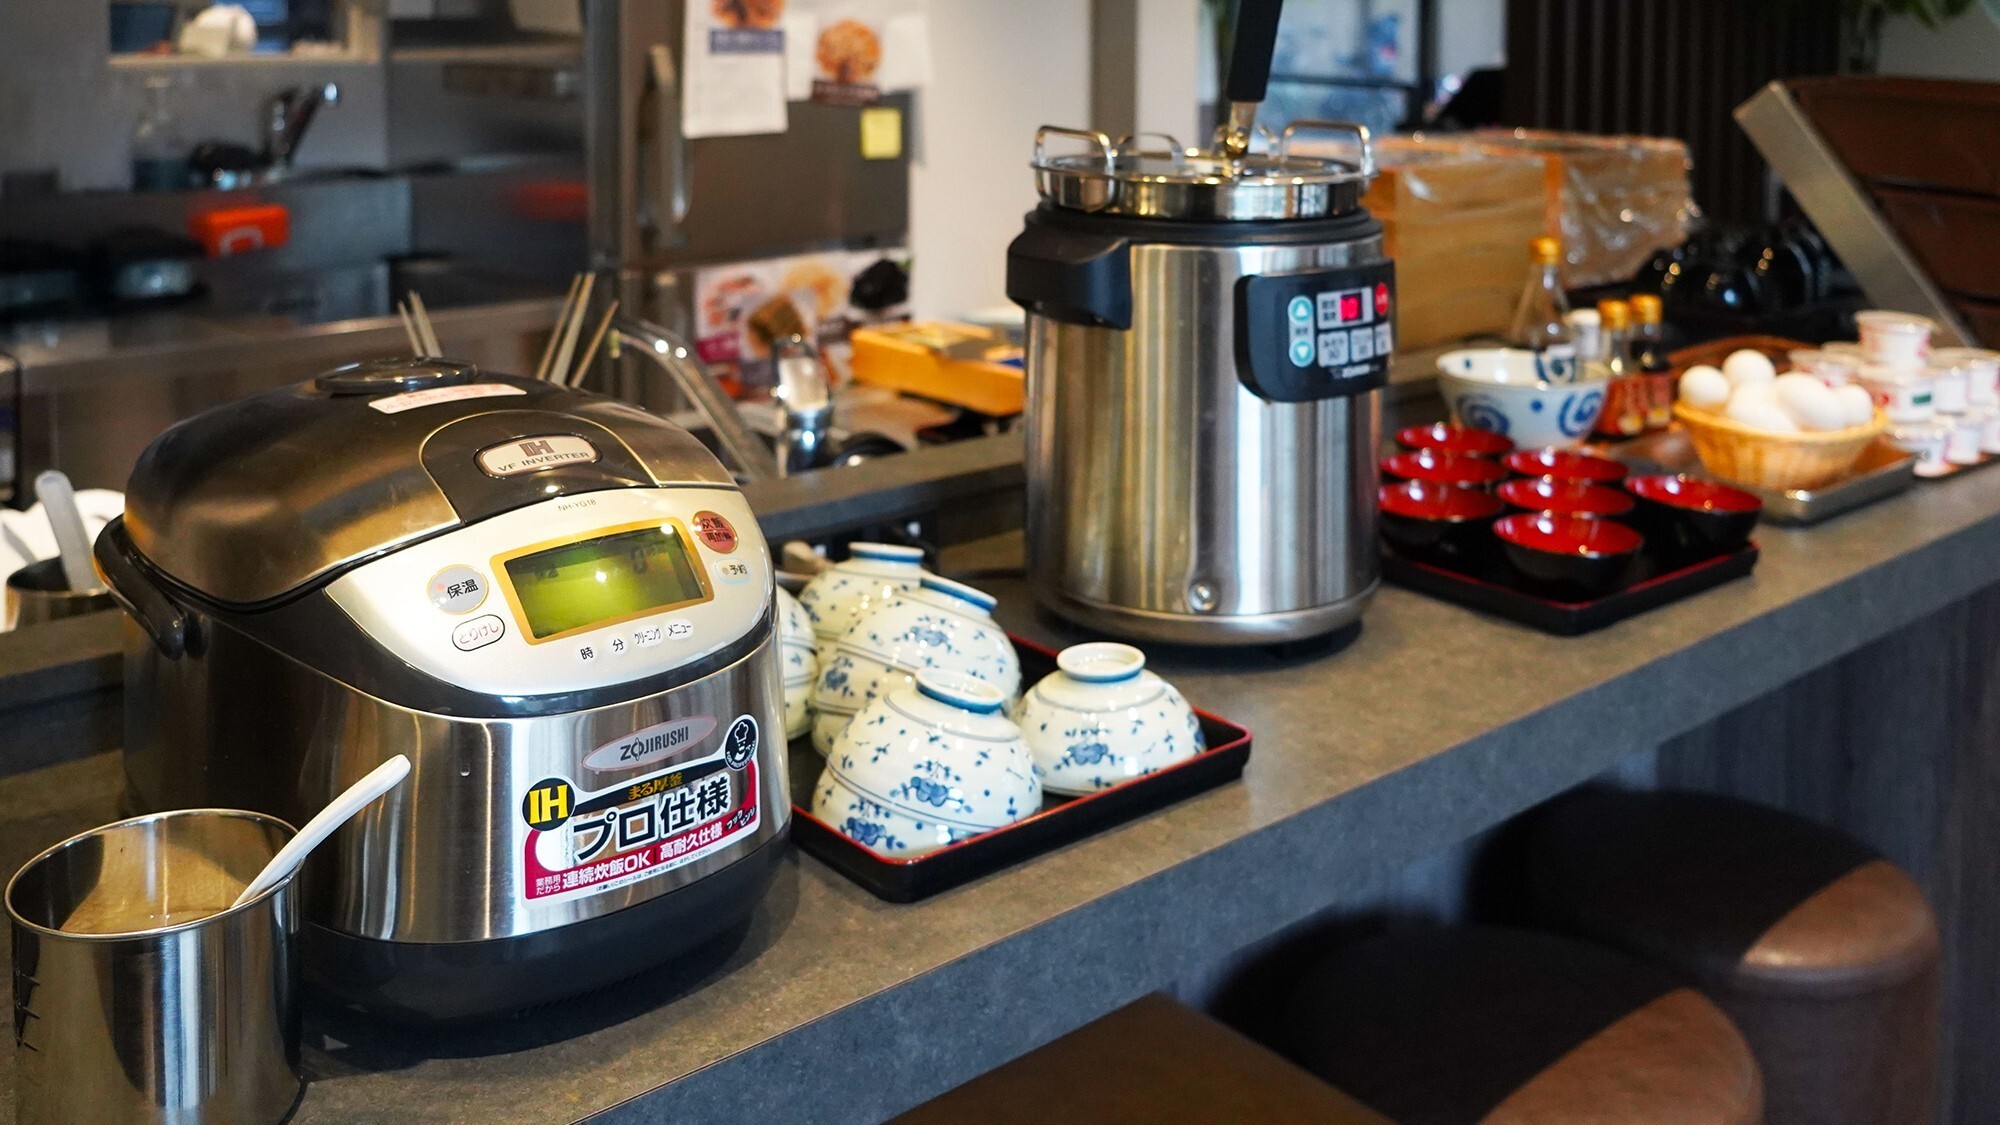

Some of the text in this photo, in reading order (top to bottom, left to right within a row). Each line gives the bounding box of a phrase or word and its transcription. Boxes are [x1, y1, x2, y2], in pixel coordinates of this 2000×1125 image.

[519, 440, 555, 457] IH
[498, 452, 590, 472] VF INVERTER
[558, 499, 597, 512] NH-YG18
[729, 564, 748, 575] 予約
[447, 579, 479, 599] 保温
[459, 622, 499, 644] とりけし
[668, 623, 692, 637] メニュー
[580, 646, 594, 660] 時
[612, 638, 624, 652] 分
[620, 726, 689, 761] ZOJIRUSHI
[628, 772, 683, 800] まる厚釜
[529, 784, 569, 825] IH
[573, 776, 730, 861] プロ仕様
[660, 821, 723, 861] 高耐久仕様
[562, 850, 652, 889] 連続炊飯OK
[536, 882, 561, 895] だから
